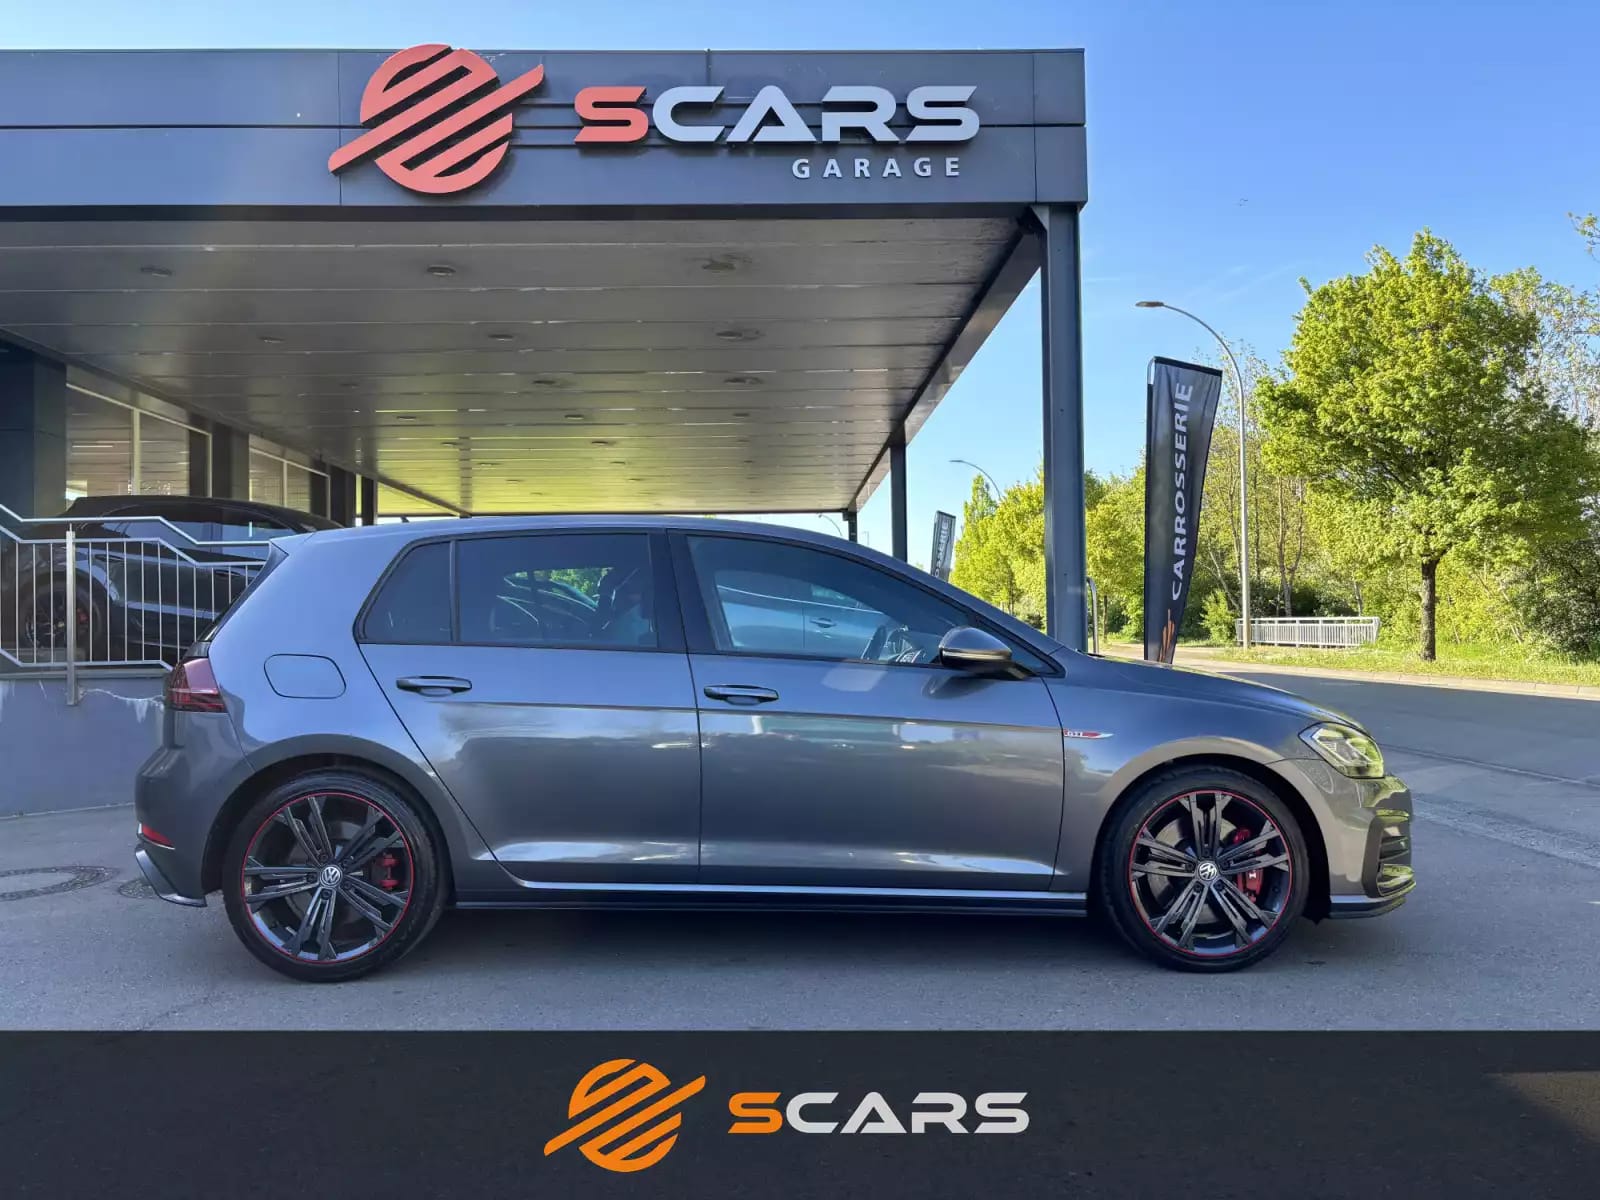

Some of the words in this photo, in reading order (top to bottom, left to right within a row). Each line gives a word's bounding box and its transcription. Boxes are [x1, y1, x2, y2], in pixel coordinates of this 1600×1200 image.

[574, 85, 981, 142] SCARS
[792, 157, 960, 179] GARAGE
[1172, 383, 1194, 600] CARROSSERIE
